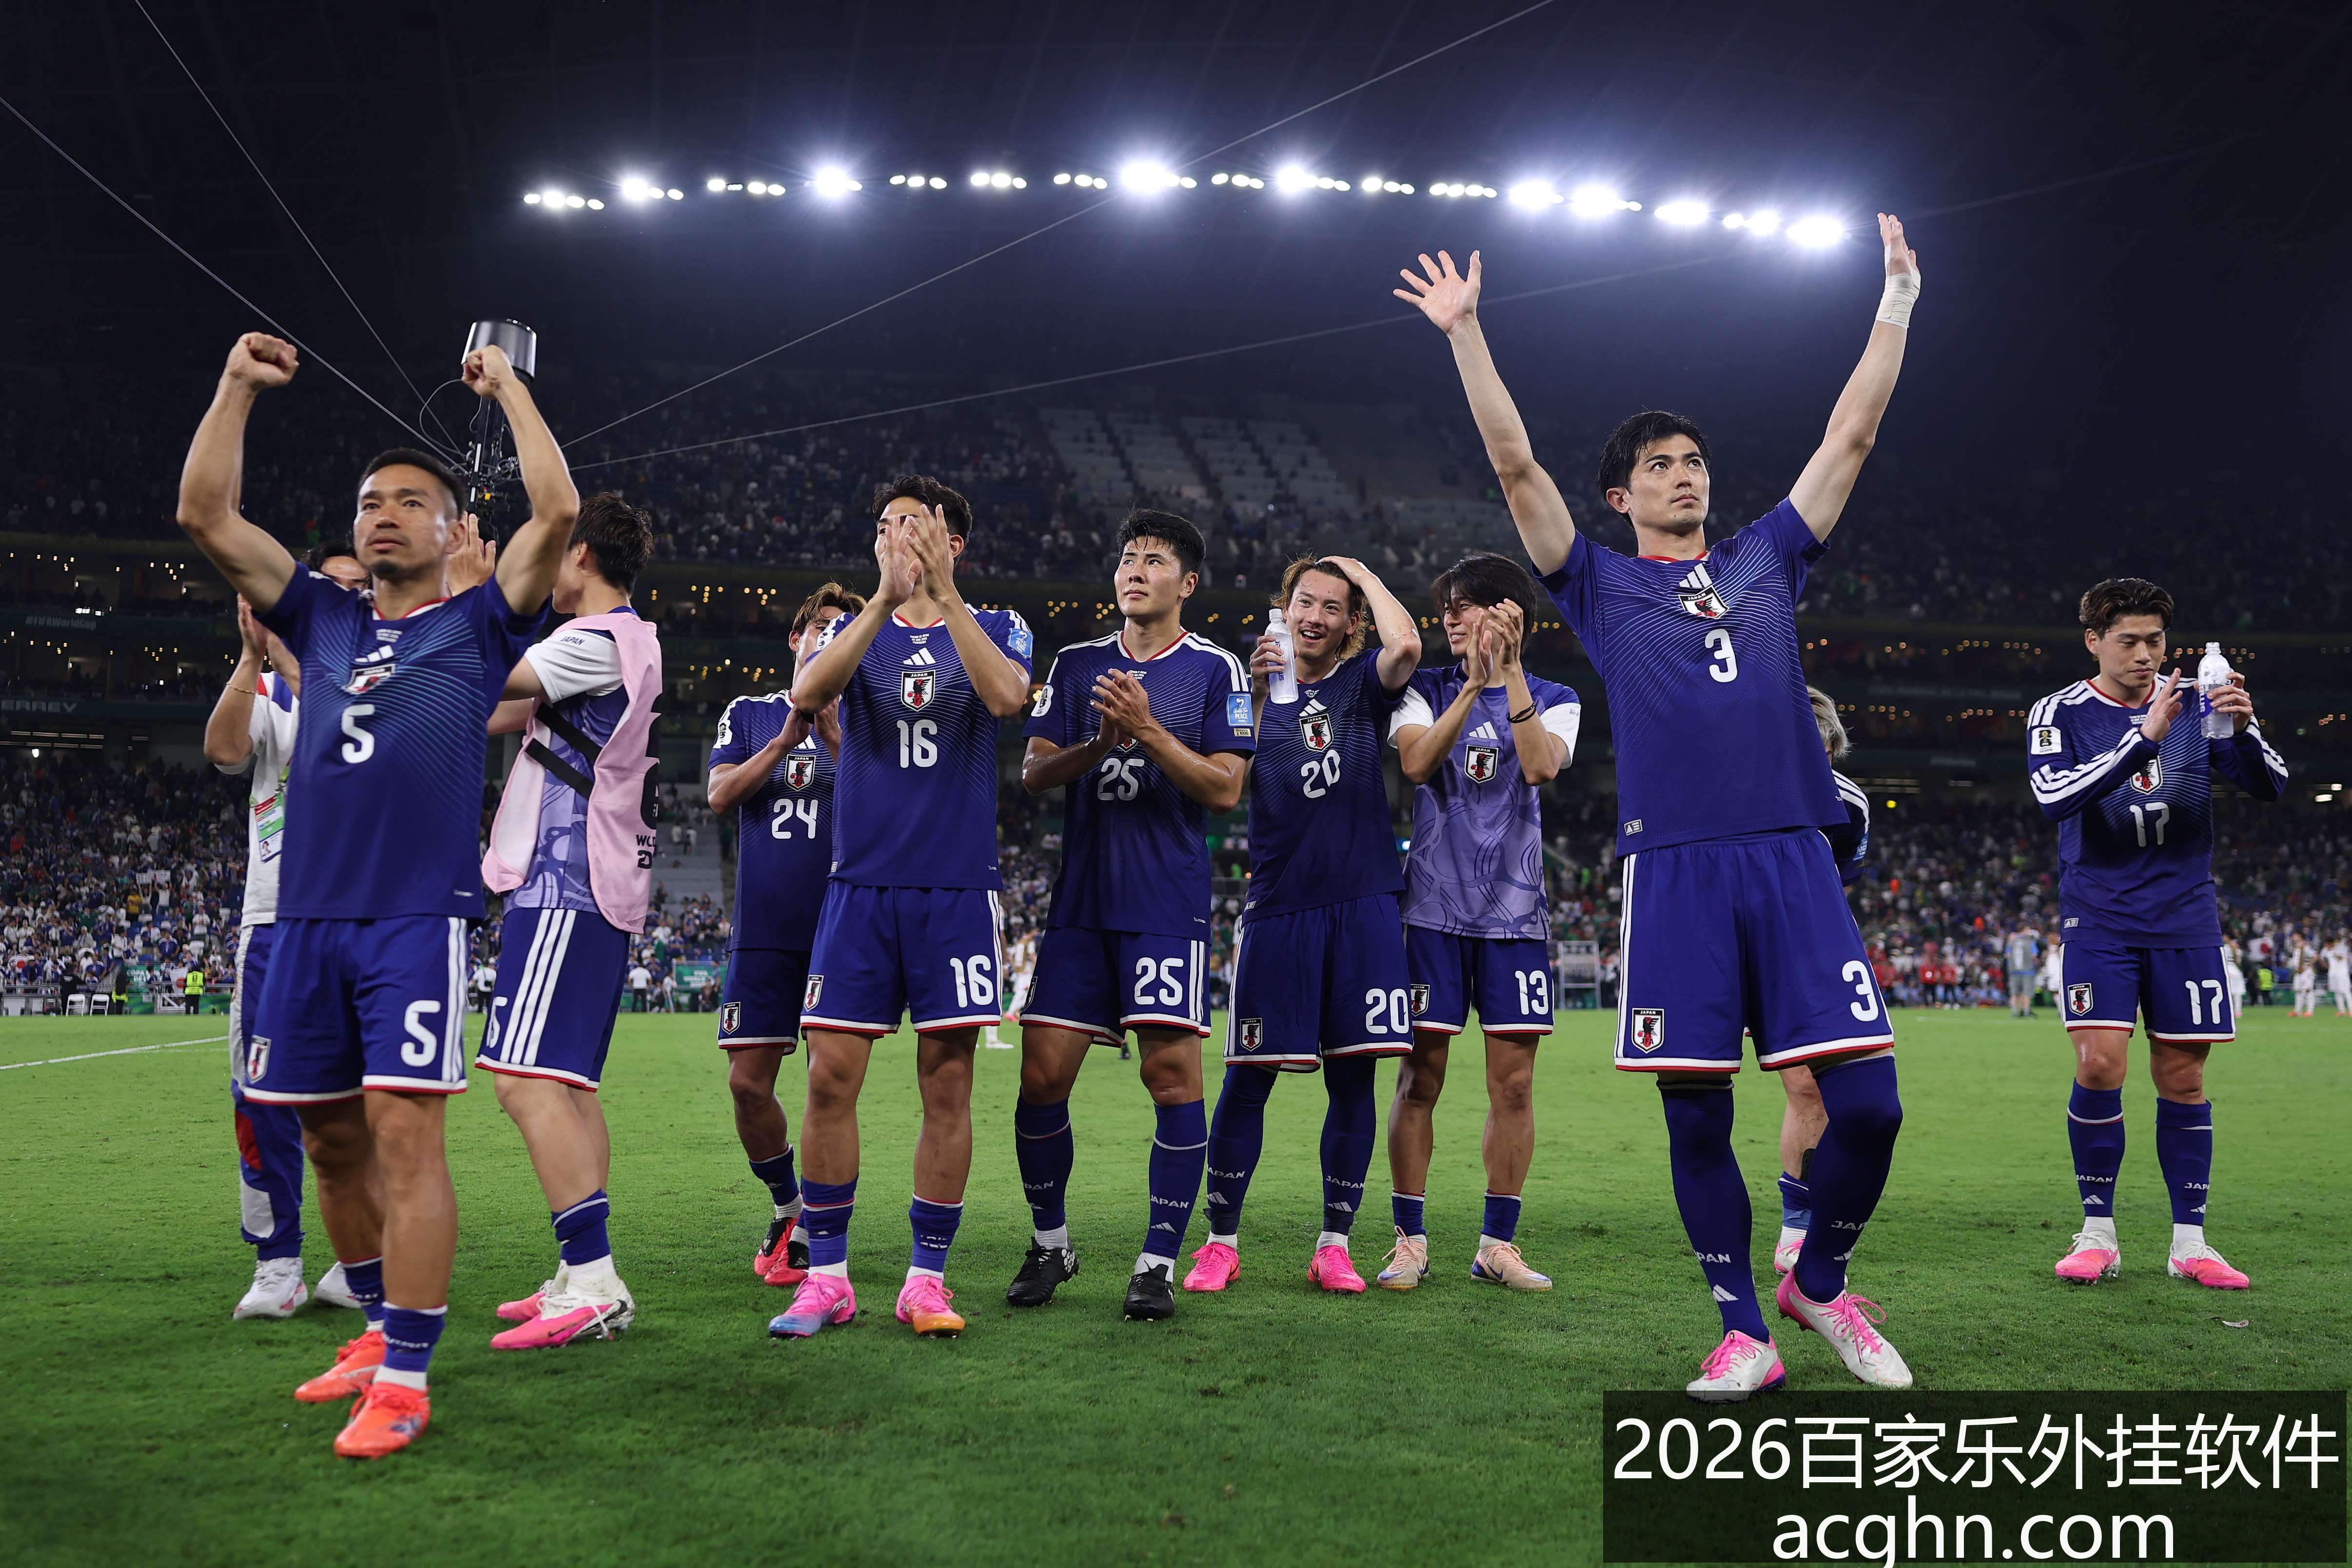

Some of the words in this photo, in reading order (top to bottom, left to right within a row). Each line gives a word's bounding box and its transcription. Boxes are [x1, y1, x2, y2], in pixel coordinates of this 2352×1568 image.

[1687, 592, 1706, 601] JAPAN
[25, 615, 97, 631] #FIFAWorldCup
[560, 636, 586, 645] JAPAN
[1705, 628, 1738, 683] 3
[341, 704, 375, 764] 5
[897, 720, 938, 768] 16
[1098, 758, 1145, 802] 25
[1300, 749, 1341, 799] 20
[771, 799, 818, 839] 24
[2129, 802, 2170, 847] 17
[950, 955, 994, 1008] 16
[1134, 957, 1184, 1006] 25
[1514, 970, 1549, 1016] 13
[1842, 960, 1880, 1022] 3
[2185, 979, 2224, 1025] 17
[400, 1000, 441, 1067] 5
[1366, 988, 1410, 1034] 20
[1024, 1180, 1054, 1191] PAN
[1326, 1176, 1365, 1189] JAPAN
[1830, 1220, 1868, 1231] JAP
[1695, 1250, 1731, 1263] PAN
